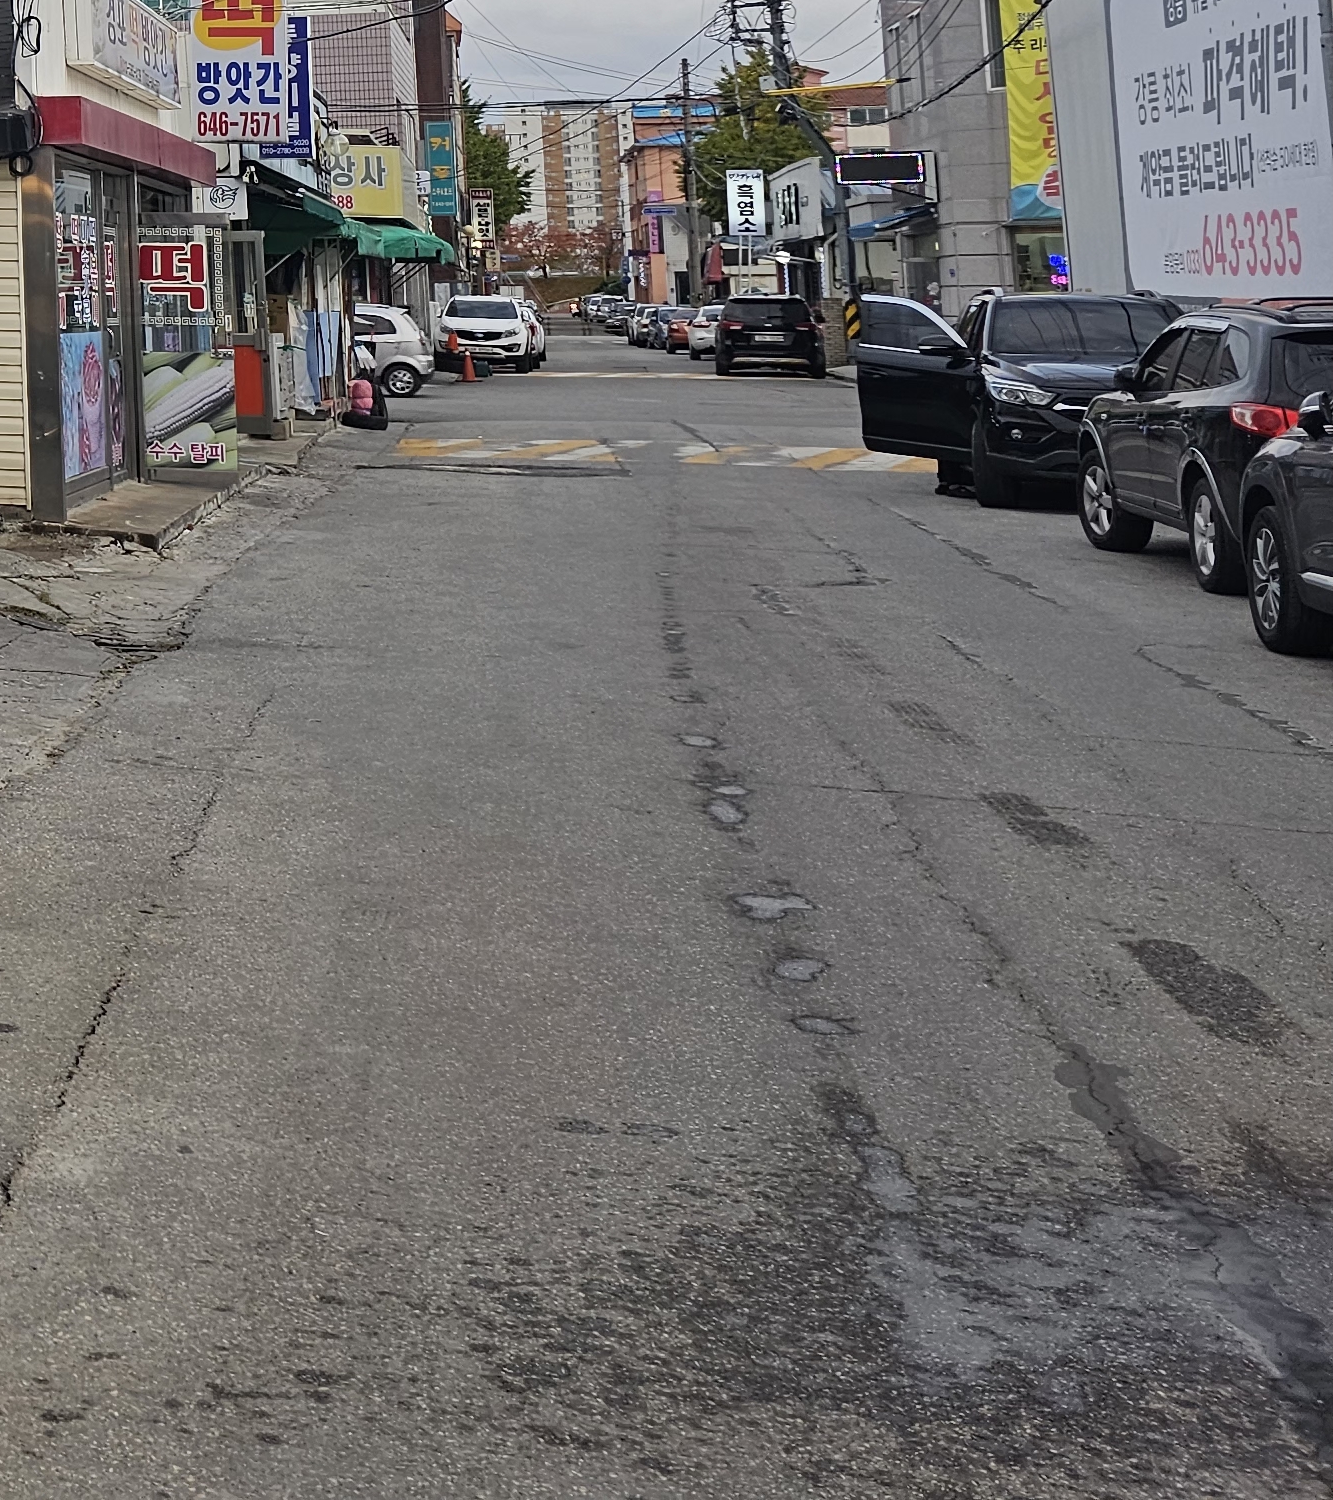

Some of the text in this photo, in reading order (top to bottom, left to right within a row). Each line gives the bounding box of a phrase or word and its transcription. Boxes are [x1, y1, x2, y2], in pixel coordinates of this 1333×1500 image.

[196, 61, 283, 106] 방앗간
[1134, 15, 1310, 126] 강릉 최초! 파격혜택!
[197, 111, 282, 137] 646-7571
[1139, 132, 1256, 199] 계약금 돌려드립니다
[736, 183, 758, 233] 흑염소
[1202, 207, 1303, 277] 643-3335
[139, 243, 207, 311] 떡
[147, 441, 226, 463] 수수 탈피
